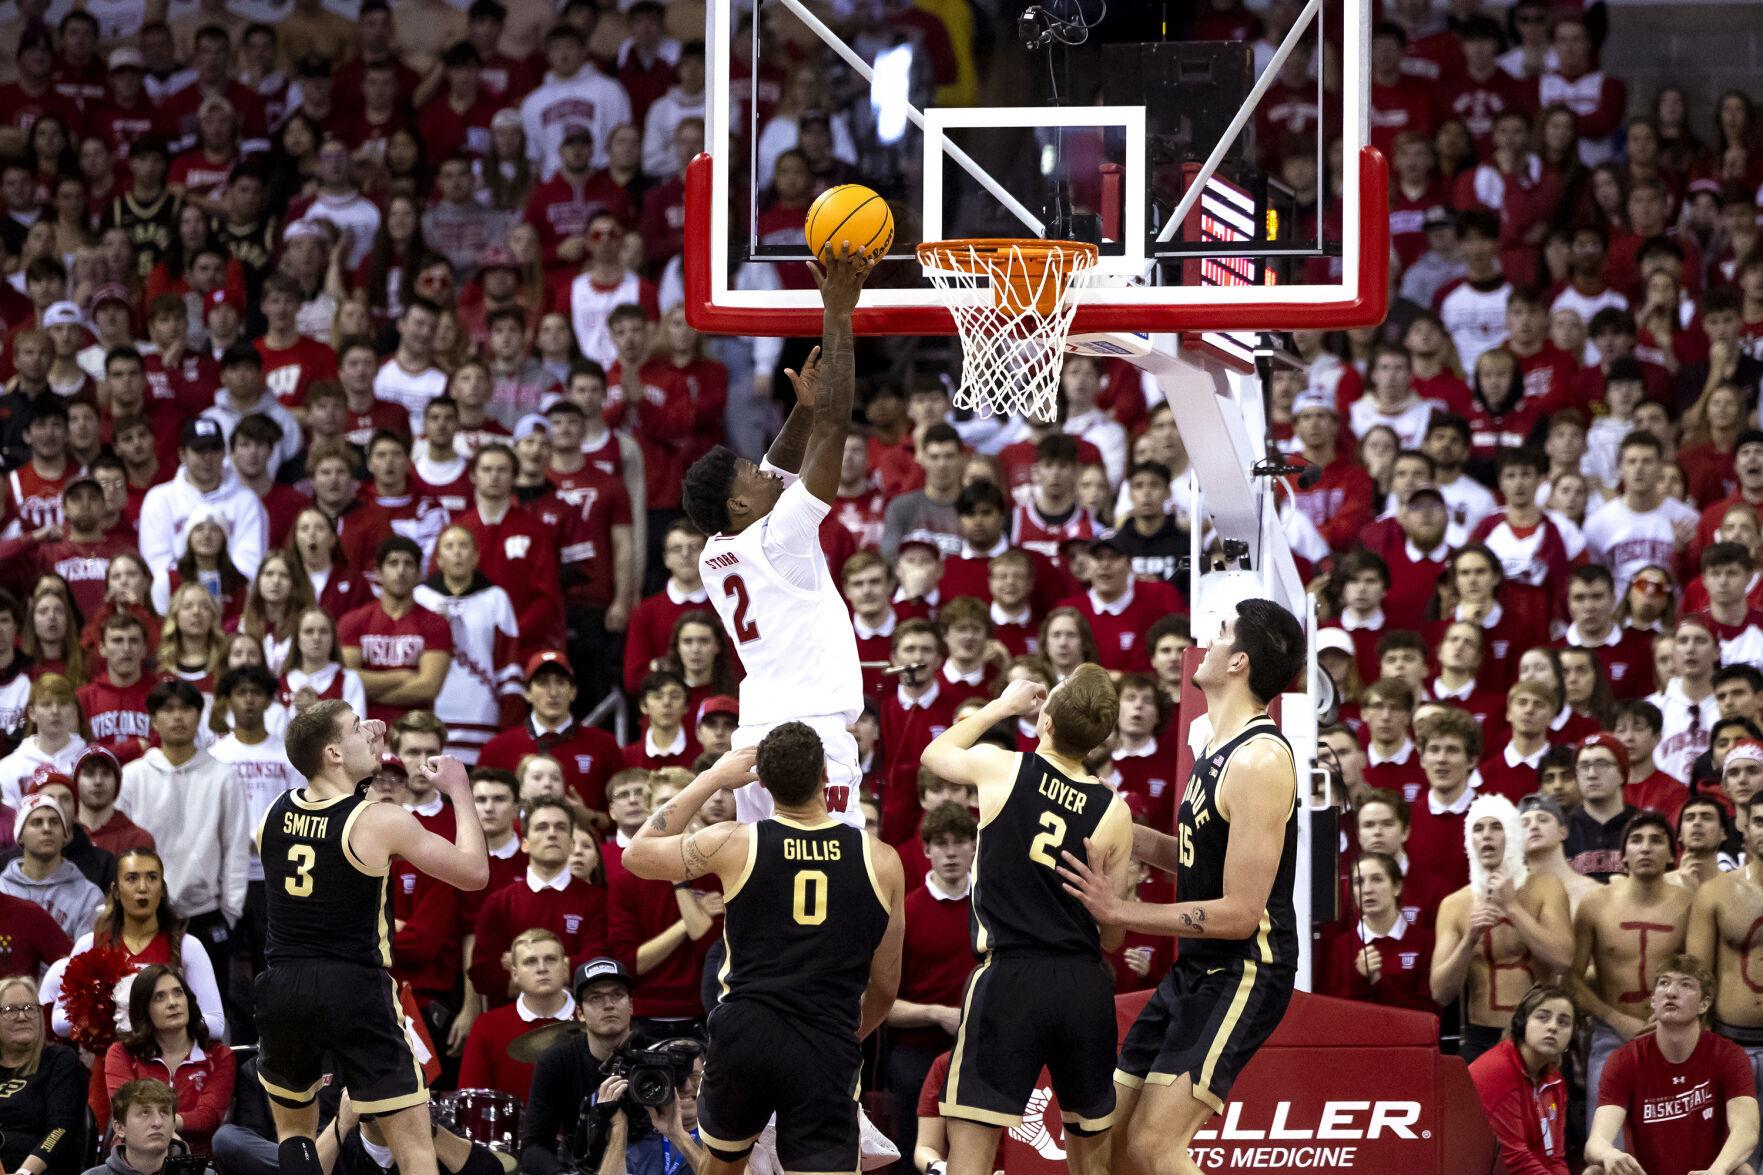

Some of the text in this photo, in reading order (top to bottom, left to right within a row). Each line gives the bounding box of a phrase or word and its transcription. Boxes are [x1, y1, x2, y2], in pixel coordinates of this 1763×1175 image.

[705, 552, 739, 571] STORR
[722, 571, 762, 646] 2
[1038, 773, 1088, 815] LOYER
[283, 811, 328, 839] SMITH
[1028, 810, 1067, 871] 2
[1178, 822, 1195, 868] 15
[285, 843, 316, 898] 3
[784, 838, 841, 861] GILLIS
[793, 869, 828, 926] 0
[1229, 1146, 1357, 1168] MEDICINE
